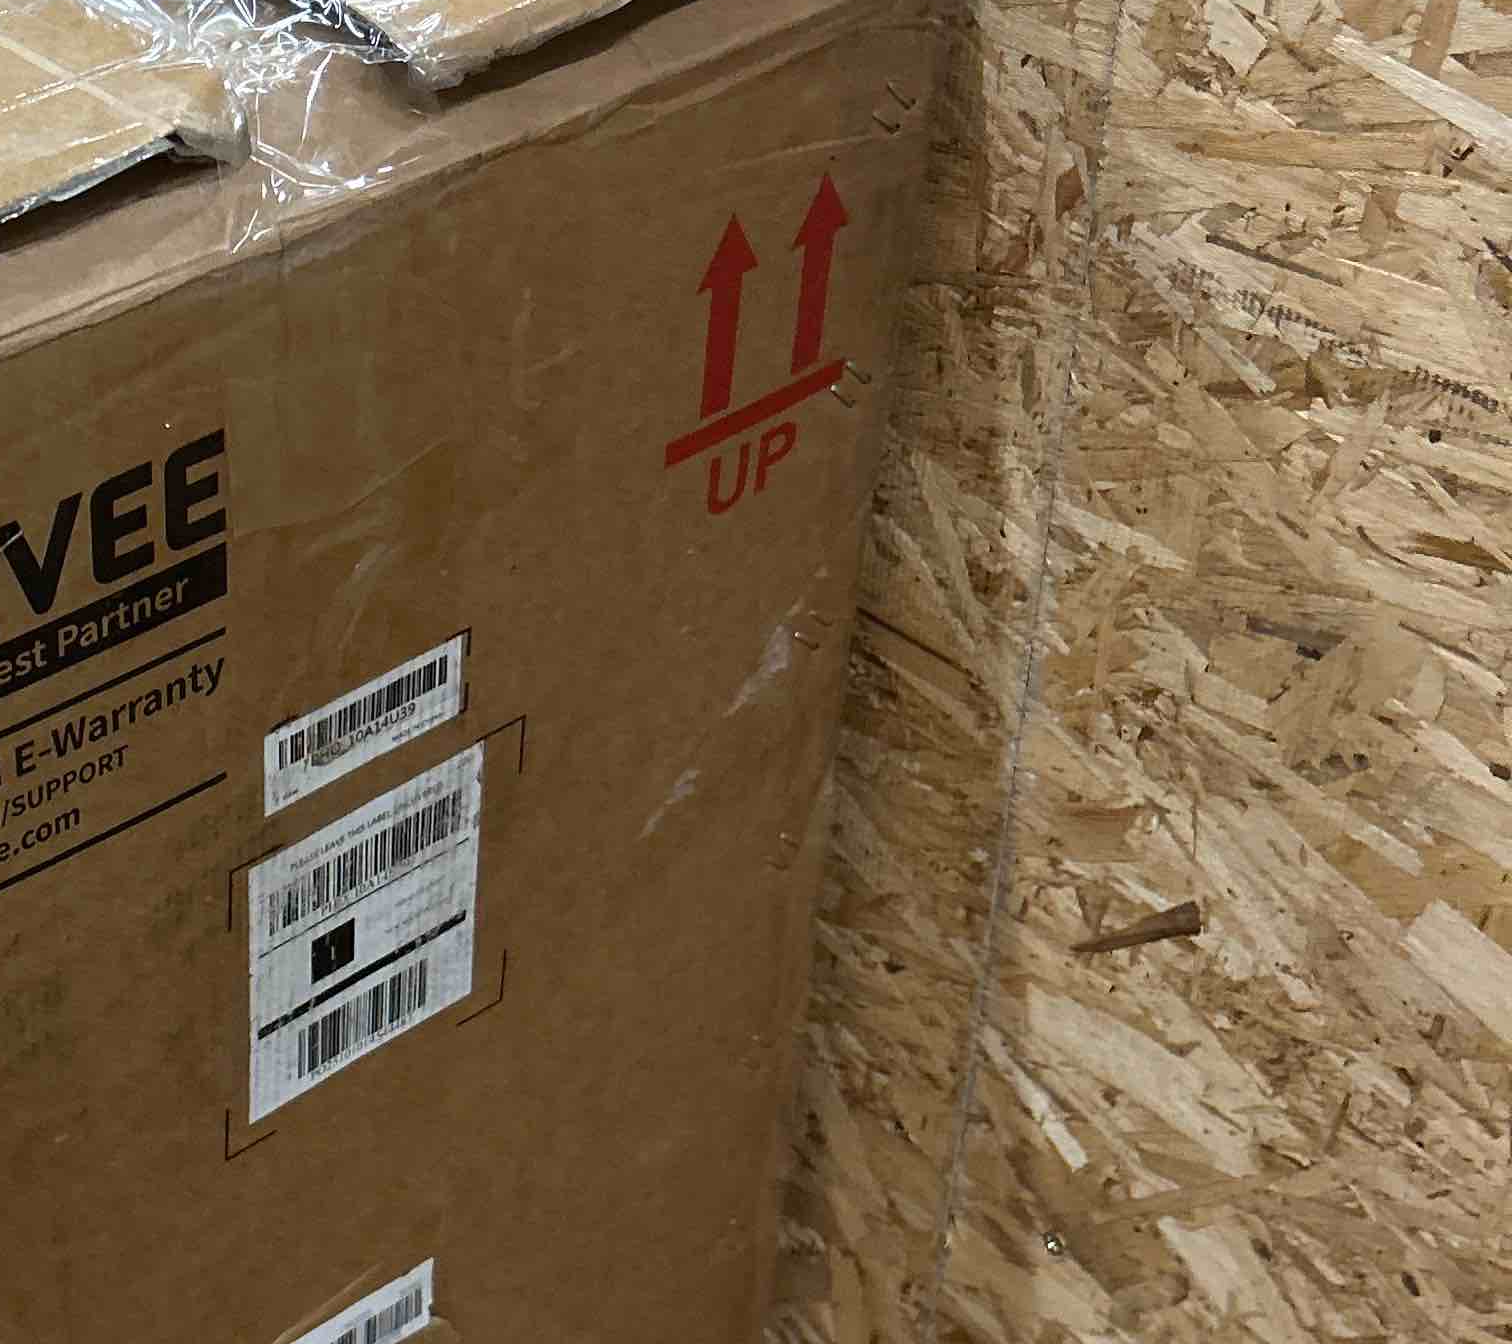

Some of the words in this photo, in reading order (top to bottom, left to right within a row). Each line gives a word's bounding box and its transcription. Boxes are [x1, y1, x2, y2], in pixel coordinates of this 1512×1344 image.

[707, 420, 799, 517] UP
[56, 575, 190, 658] Partner
[13, 656, 226, 778] E-Warranty
